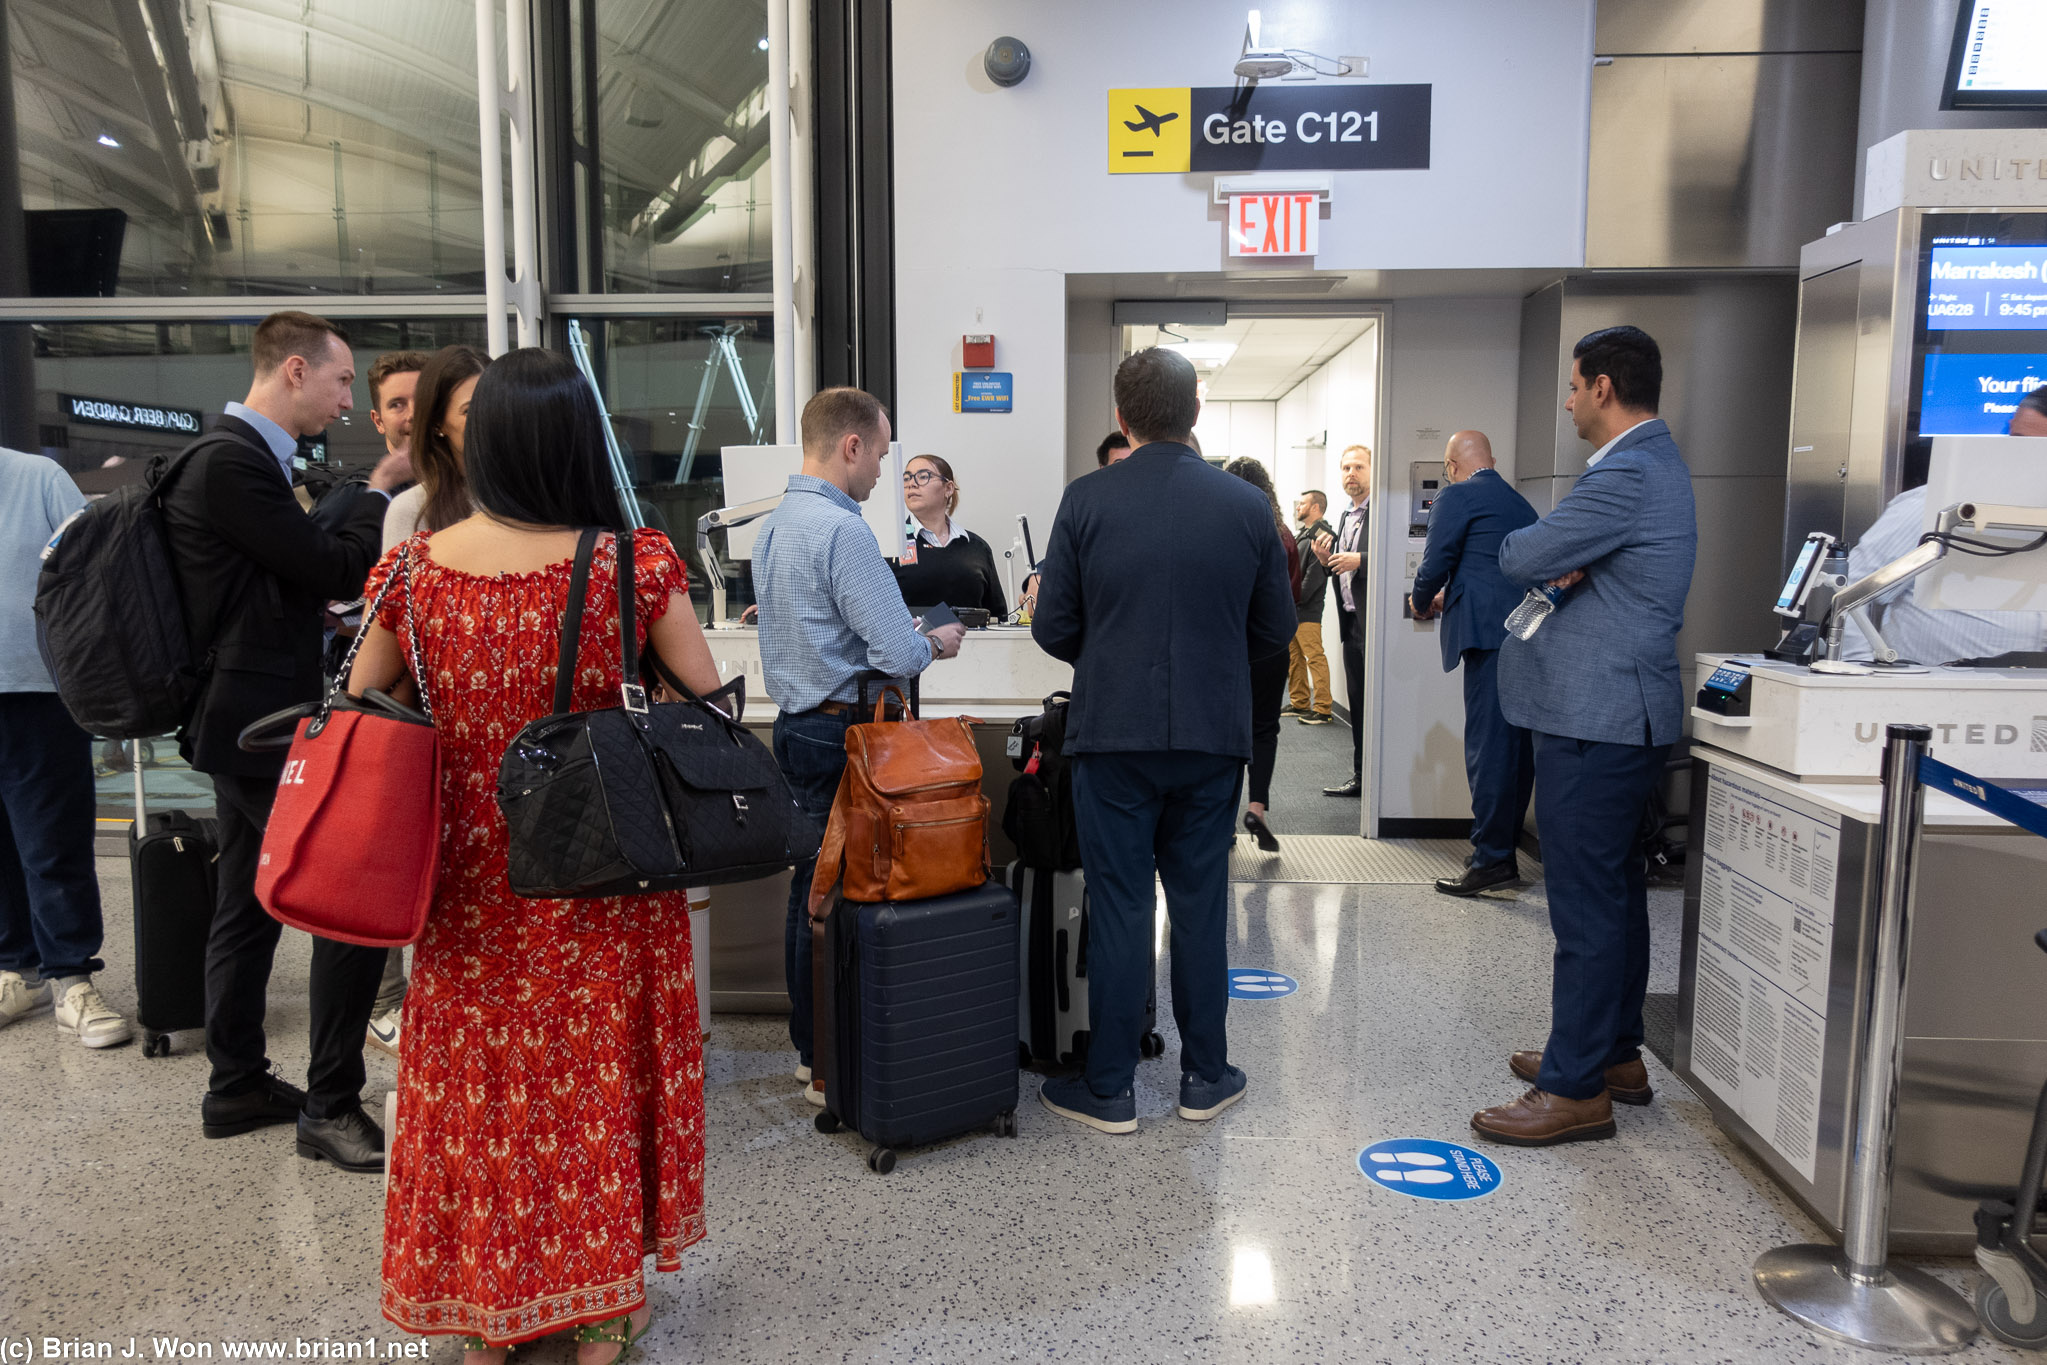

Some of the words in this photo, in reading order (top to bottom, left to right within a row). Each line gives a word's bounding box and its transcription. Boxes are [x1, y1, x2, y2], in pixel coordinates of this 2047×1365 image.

[1203, 113, 1287, 144] Gate
[1296, 111, 1379, 142] C121
[1239, 196, 1313, 253] EXIT
[1931, 261, 2038, 280] Marrakesh
[1928, 303, 1974, 316] UA628
[1999, 303, 2032, 316] 9:45
[1978, 376, 2020, 393] Your
[1855, 722, 2019, 745] UTED
[1449, 1149, 1471, 1171] STAND
[1460, 1171, 1481, 1190] HERE
[1469, 1157, 1493, 1182] PLEASE
